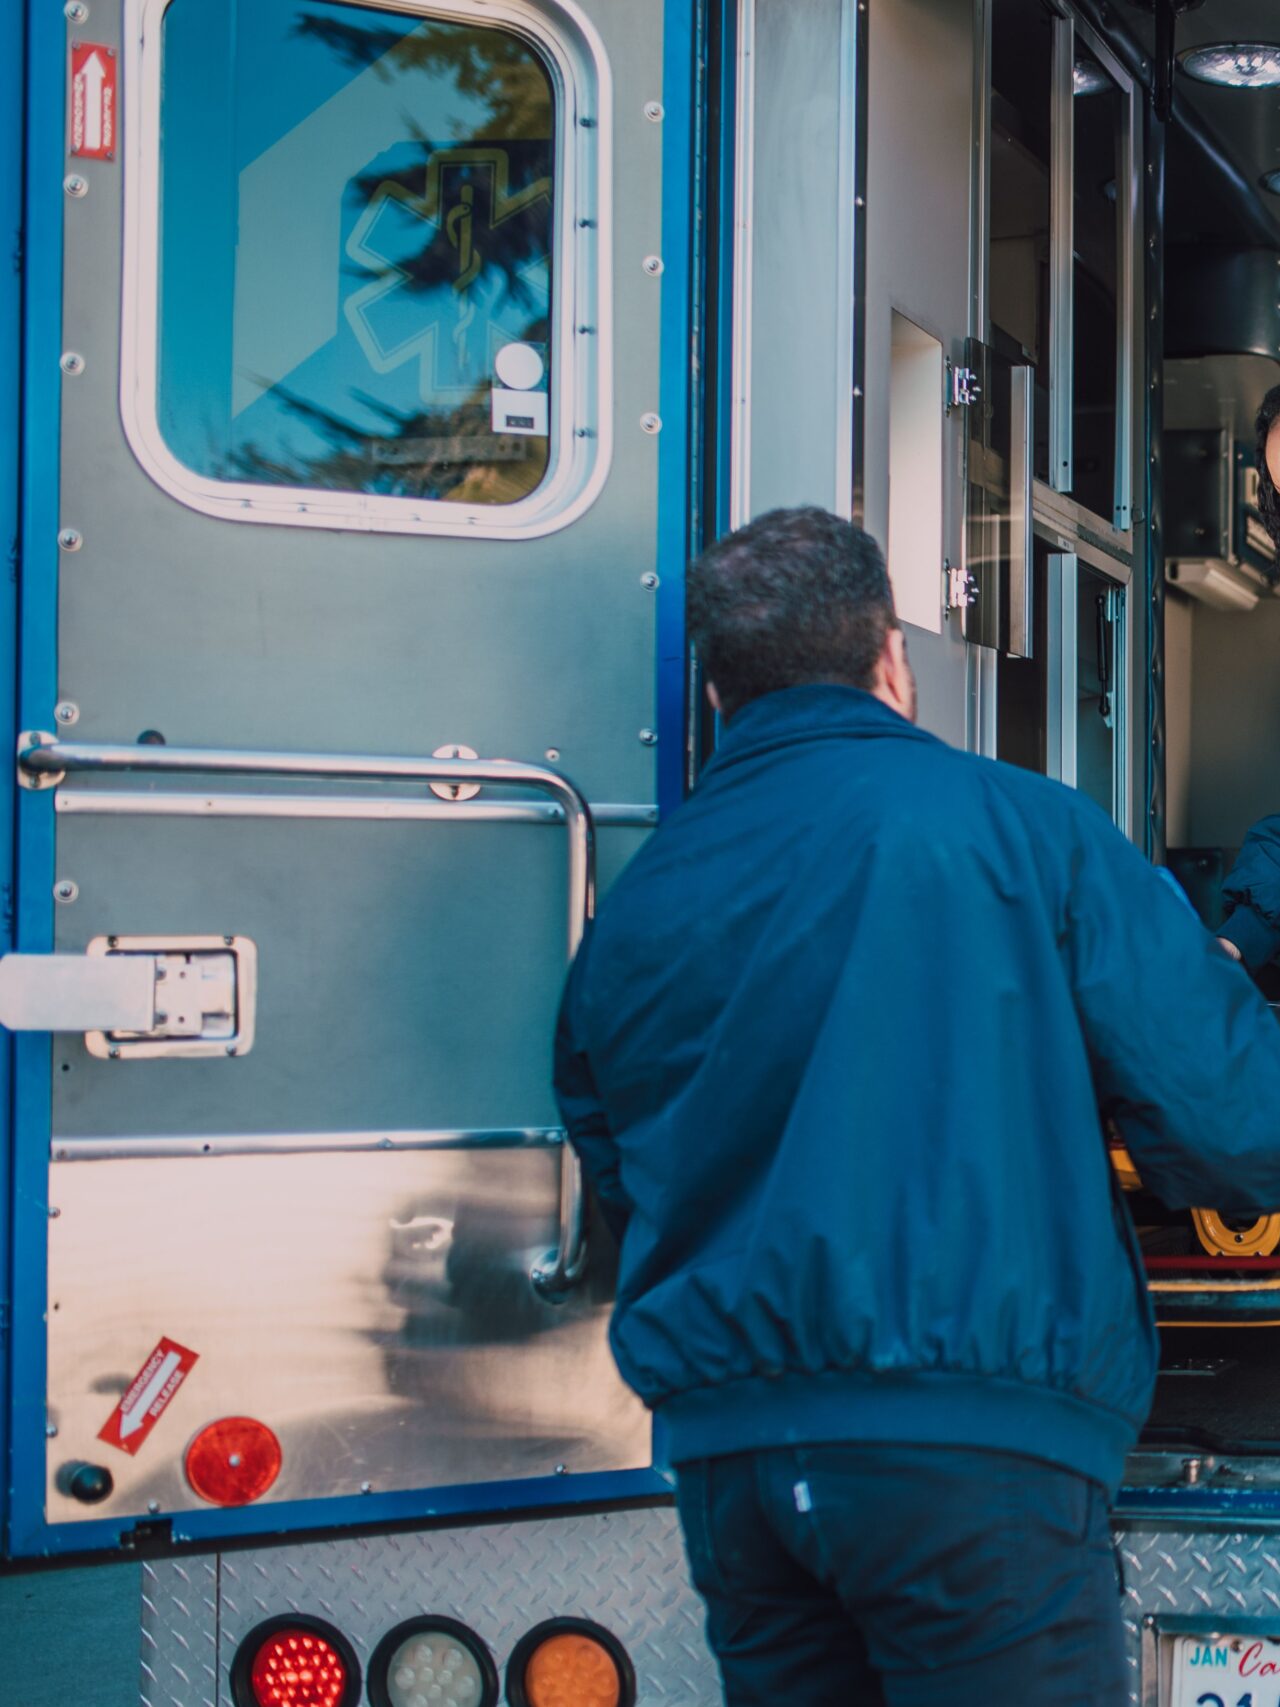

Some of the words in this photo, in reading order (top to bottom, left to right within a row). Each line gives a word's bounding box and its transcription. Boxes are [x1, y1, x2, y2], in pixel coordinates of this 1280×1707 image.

[120, 1348, 164, 1414] EMERGENCY
[149, 1369, 185, 1417] RELEASE
[1190, 1646, 1227, 1667] JAN
